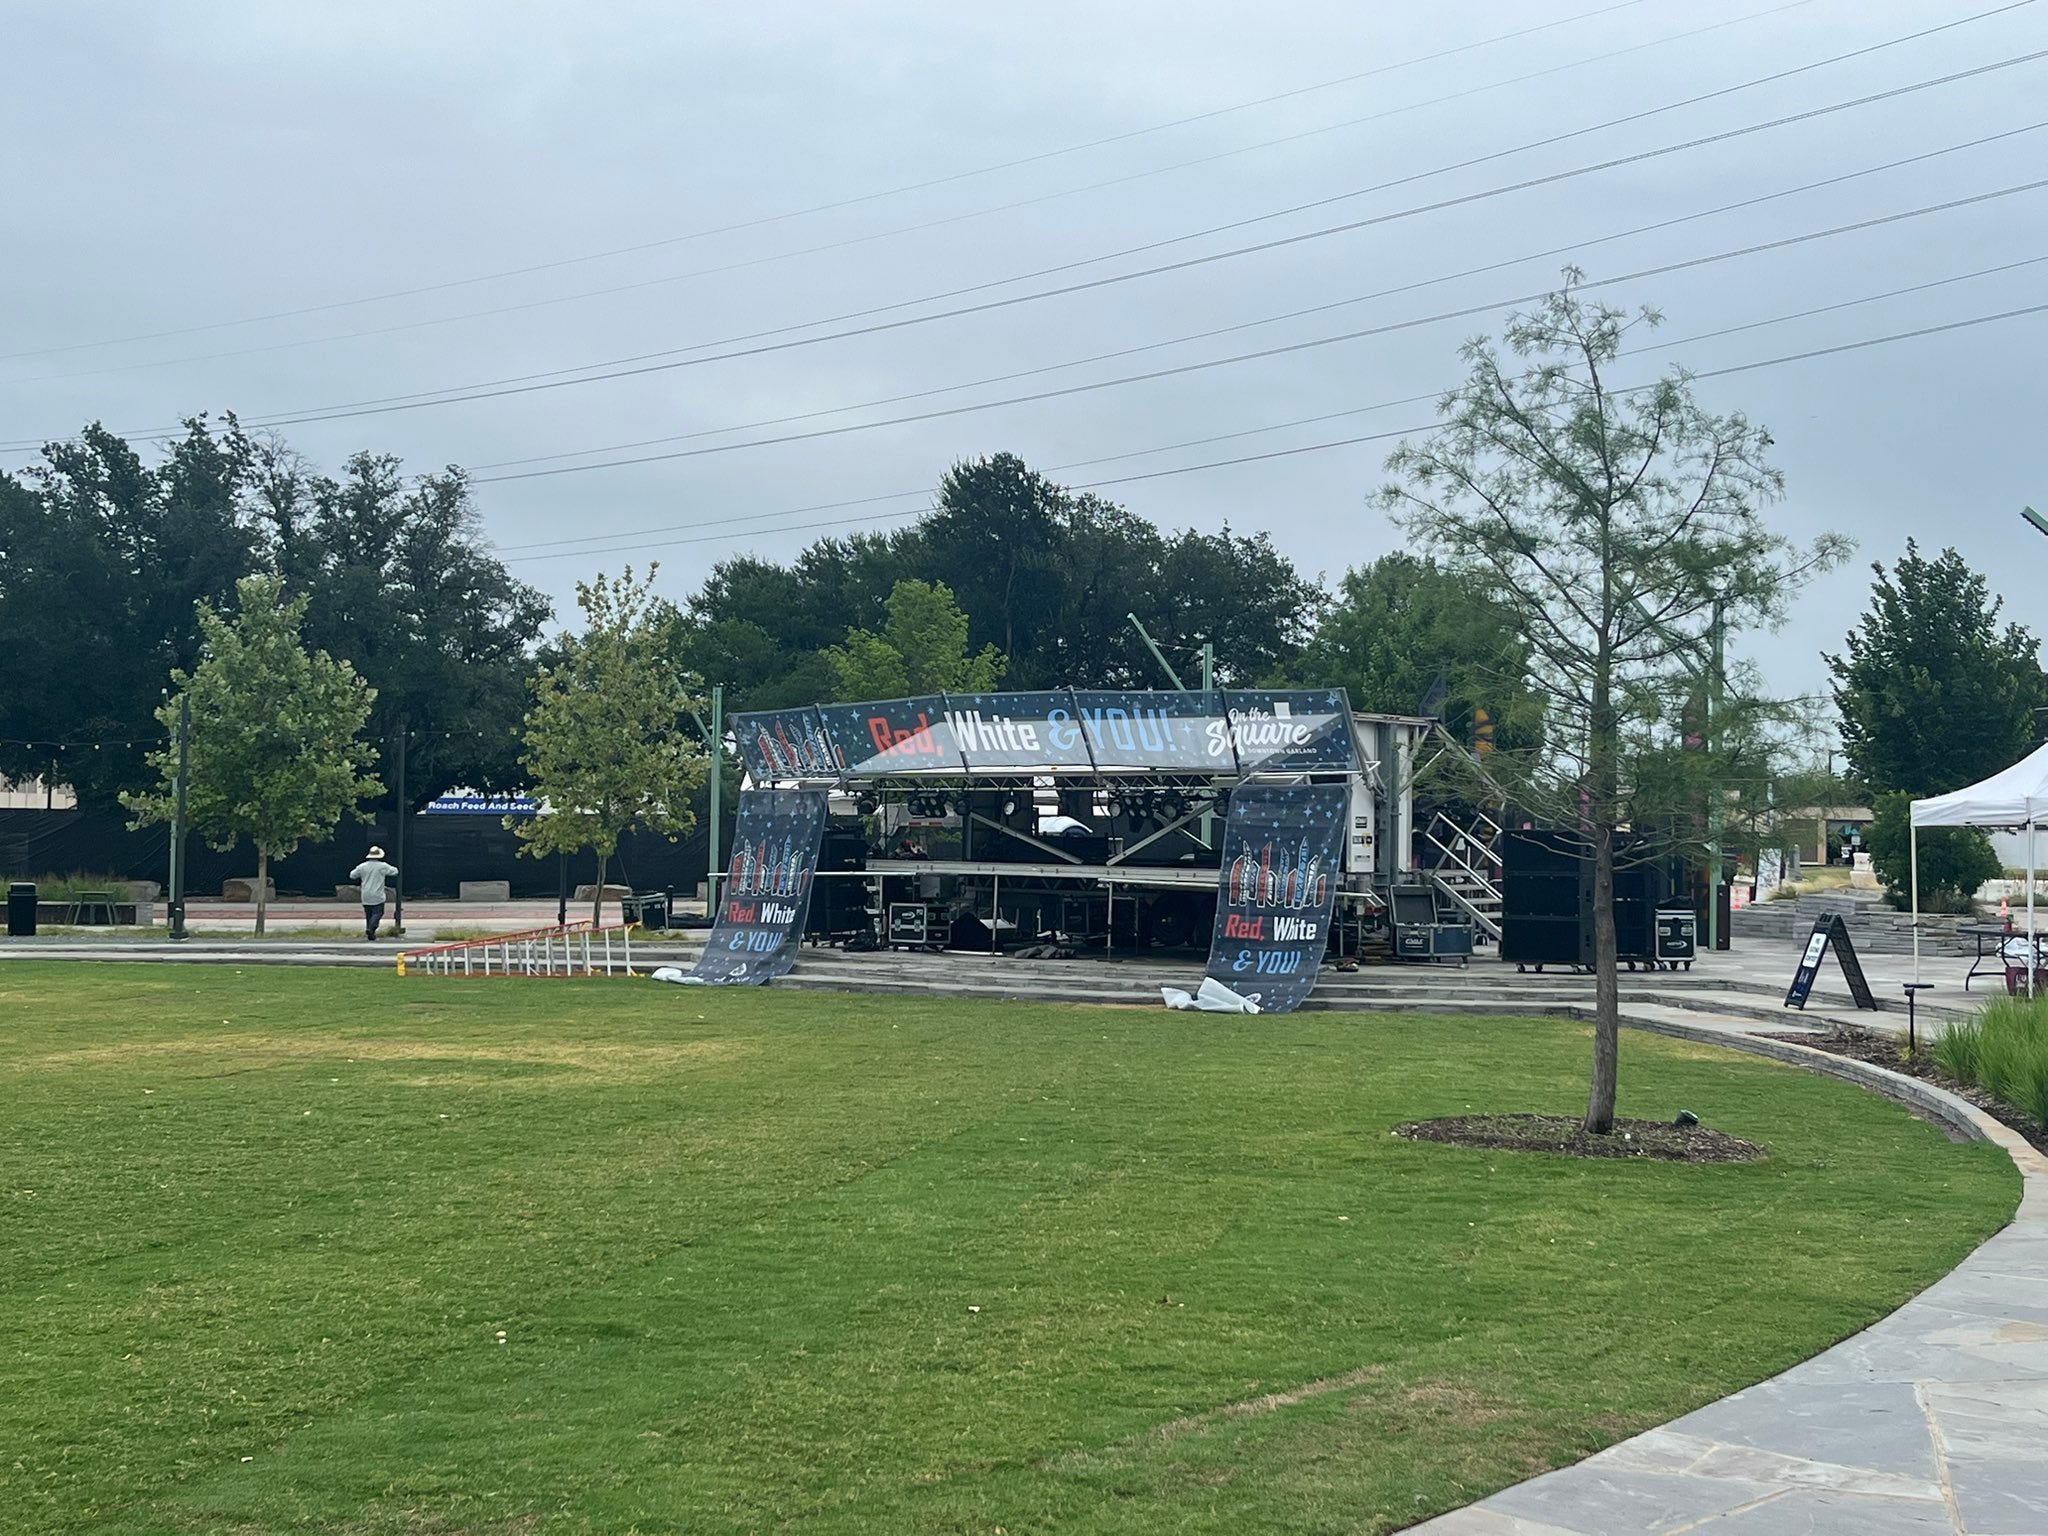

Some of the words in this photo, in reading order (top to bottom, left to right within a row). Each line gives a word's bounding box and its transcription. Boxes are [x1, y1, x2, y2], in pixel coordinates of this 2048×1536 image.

[1228, 707, 1247, 725] On
[1247, 706, 1271, 721] the
[867, 712, 944, 757] Red,
[943, 709, 1041, 752] White
[1047, 708, 1081, 751] &
[1079, 707, 1178, 752] YOU!
[1205, 719, 1312, 757] Square
[1285, 747, 1318, 755] GARLAND
[428, 801, 460, 810] Roach
[461, 801, 486, 811] Feed
[487, 801, 509, 811] And
[1224, 913, 1265, 942] Red,
[1273, 916, 1318, 942] White
[728, 930, 746, 951] &
[1232, 949, 1255, 972] &
[1256, 950, 1302, 975] YOU!
